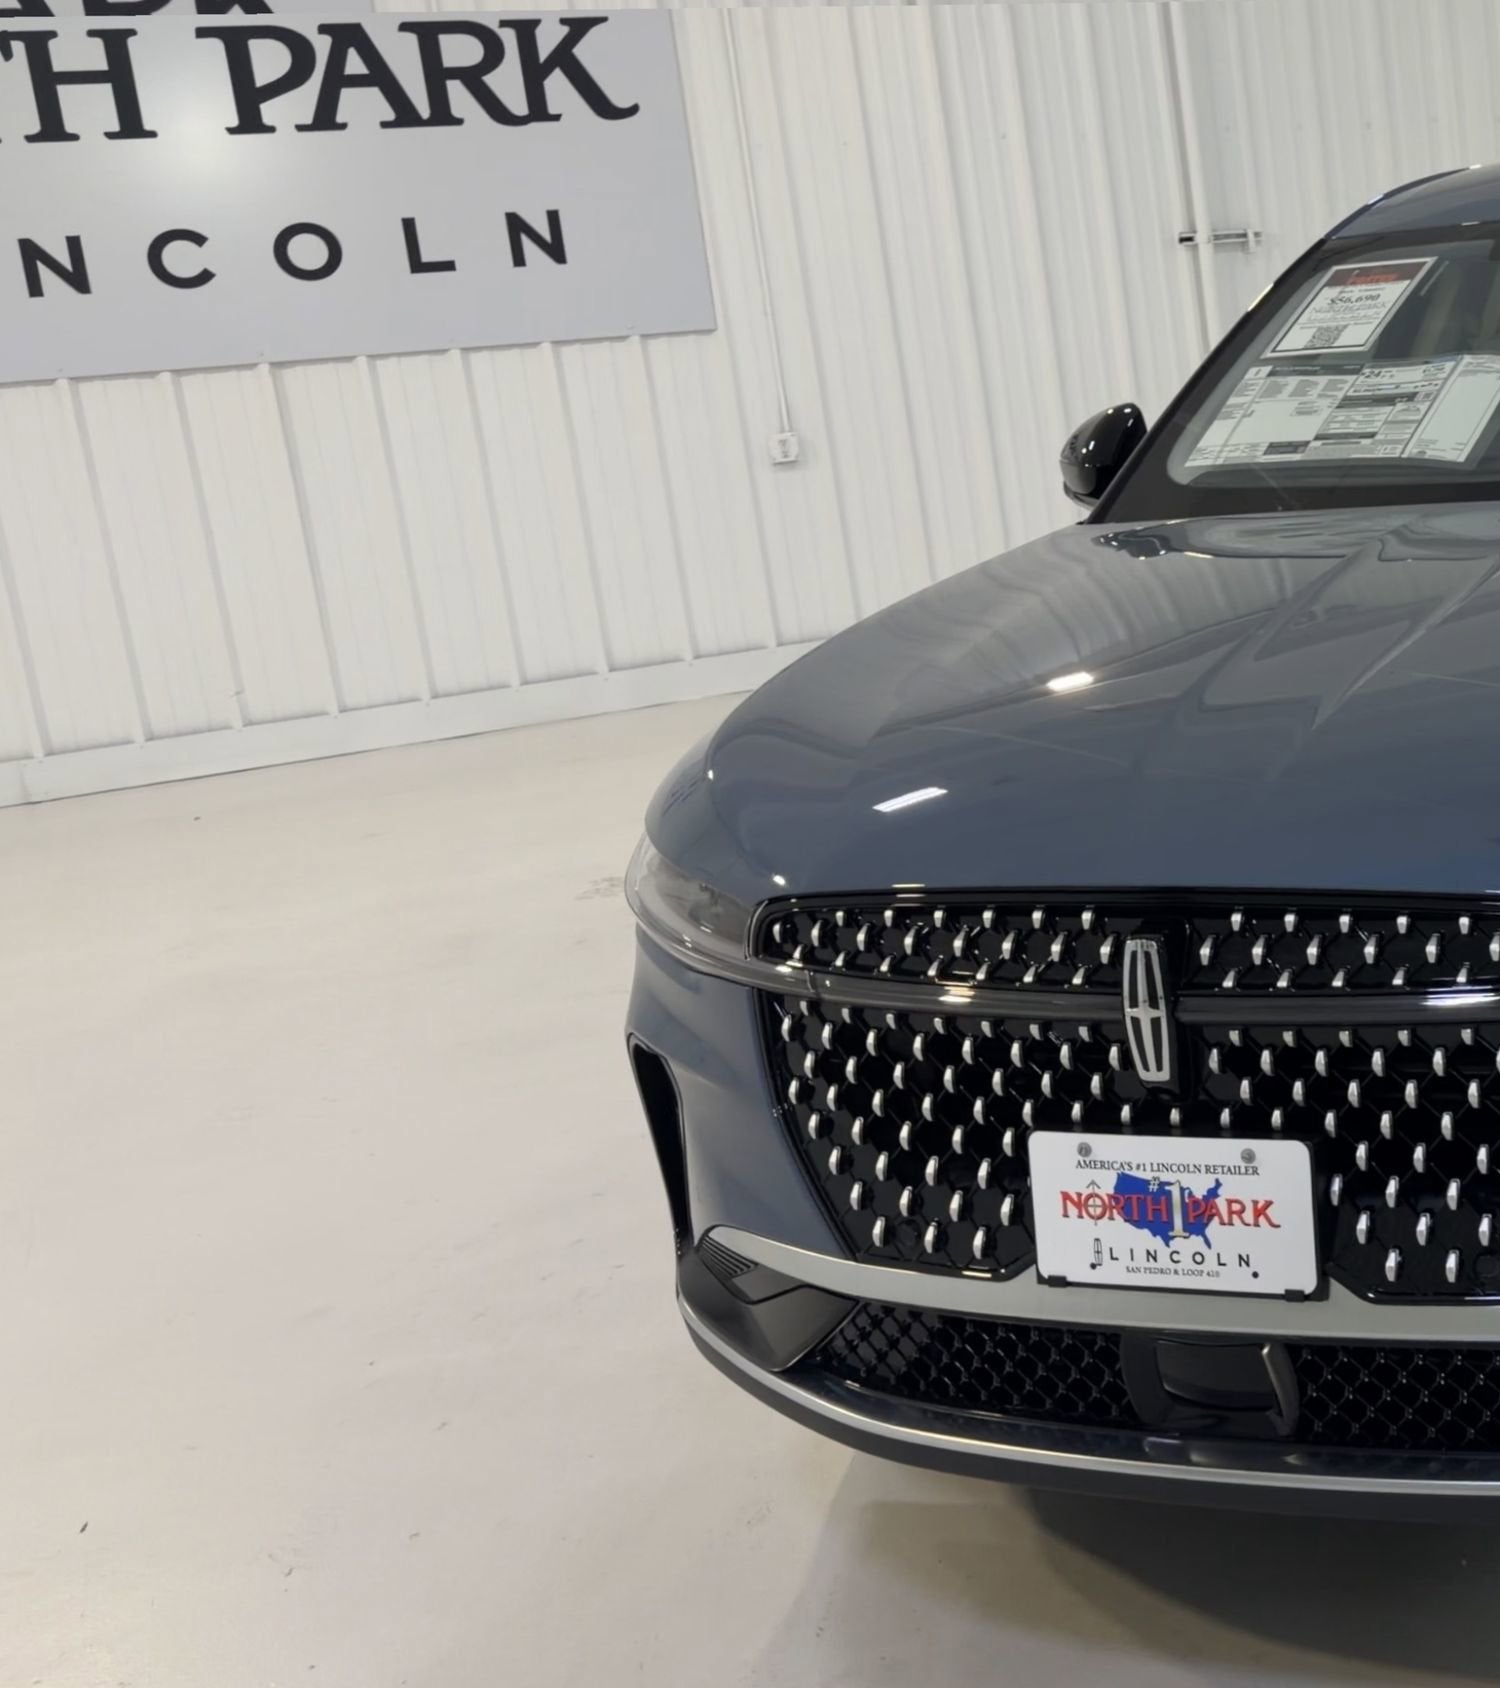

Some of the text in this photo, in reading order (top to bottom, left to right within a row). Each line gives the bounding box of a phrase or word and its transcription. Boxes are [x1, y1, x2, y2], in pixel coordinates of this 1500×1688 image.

[195, 16, 640, 135] PARK
[1075, 1159, 1260, 1176] AMERICA'S #1 LINCOLN RETAILER
[1060, 1191, 1281, 1228] NORTH PARK
[1109, 1247, 1250, 1268] LINCOLN
[1126, 1265, 1142, 1274] SAN
[1143, 1267, 1171, 1276] PEDRO
